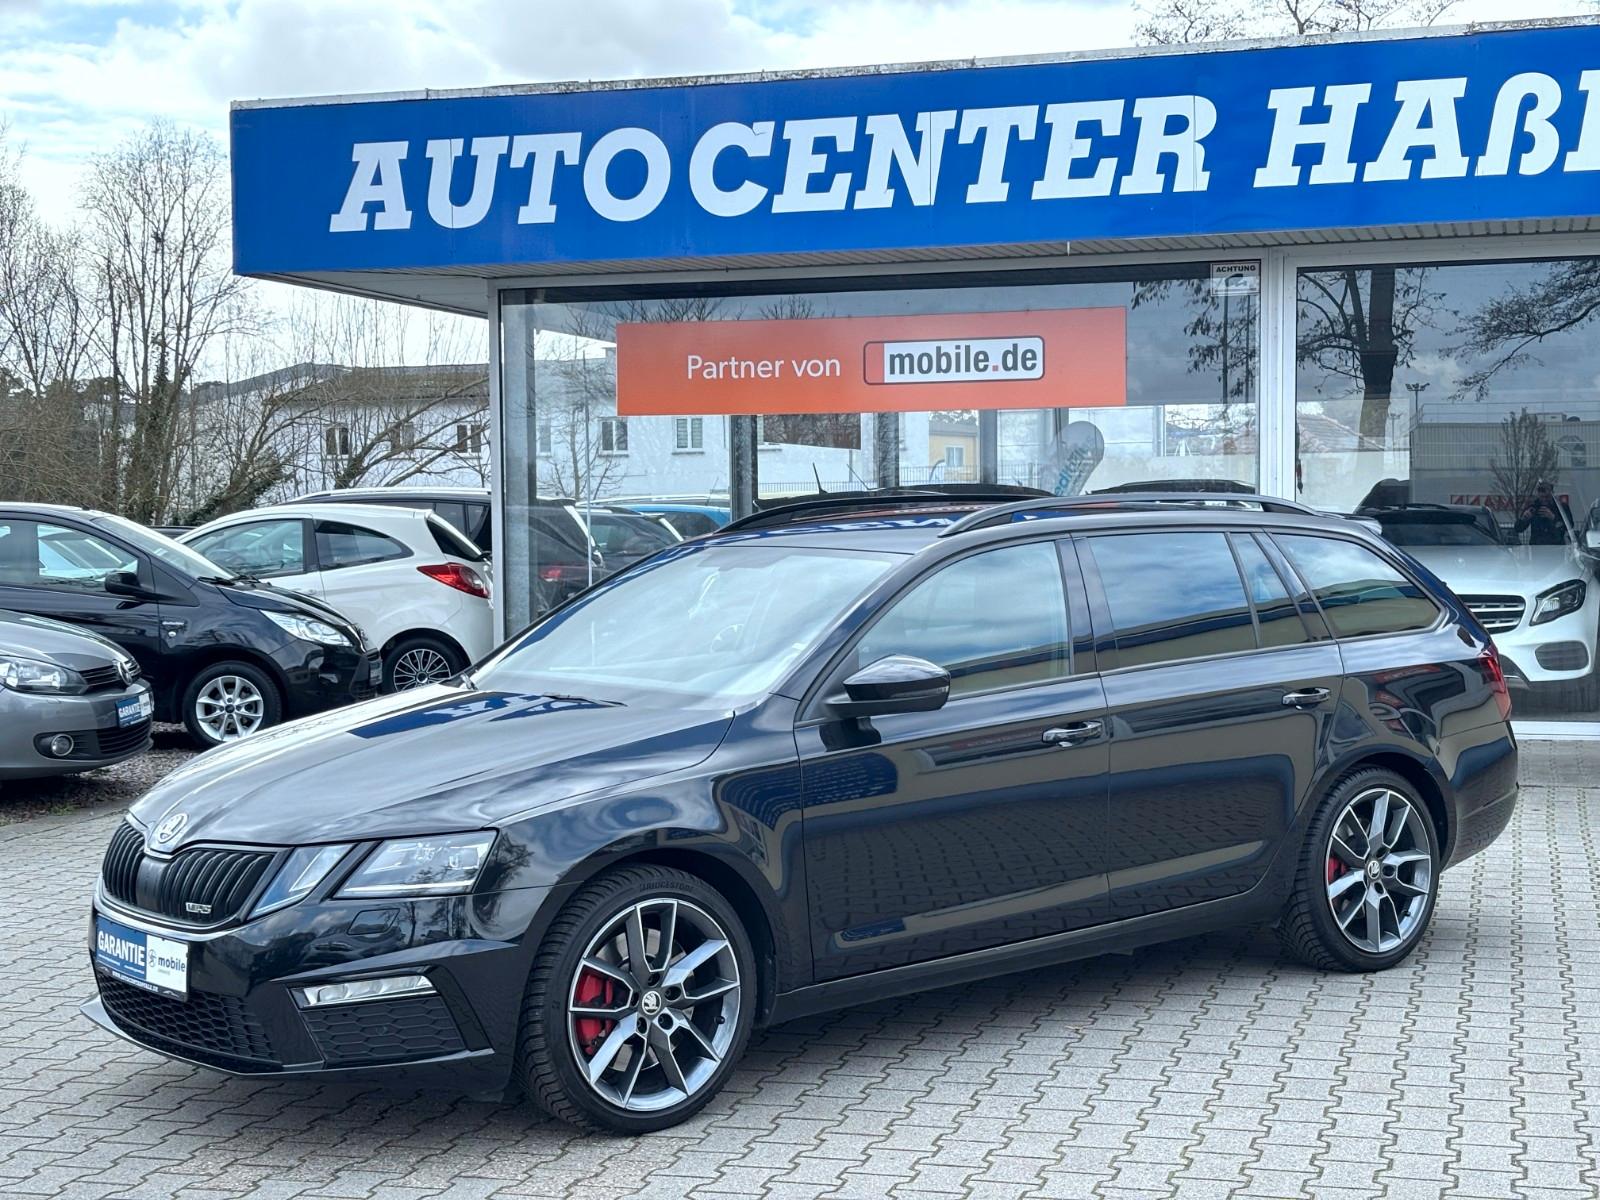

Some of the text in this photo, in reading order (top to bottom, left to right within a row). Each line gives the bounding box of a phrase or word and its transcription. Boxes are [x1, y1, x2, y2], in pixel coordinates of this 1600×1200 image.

[1216, 264, 1257, 273] ACHTUNG
[687, 342, 1038, 380] Partner von mobile.de
[118, 701, 141, 718] GARANTIE
[97, 930, 146, 967] GARANTIE
[157, 955, 187, 973] mobile
